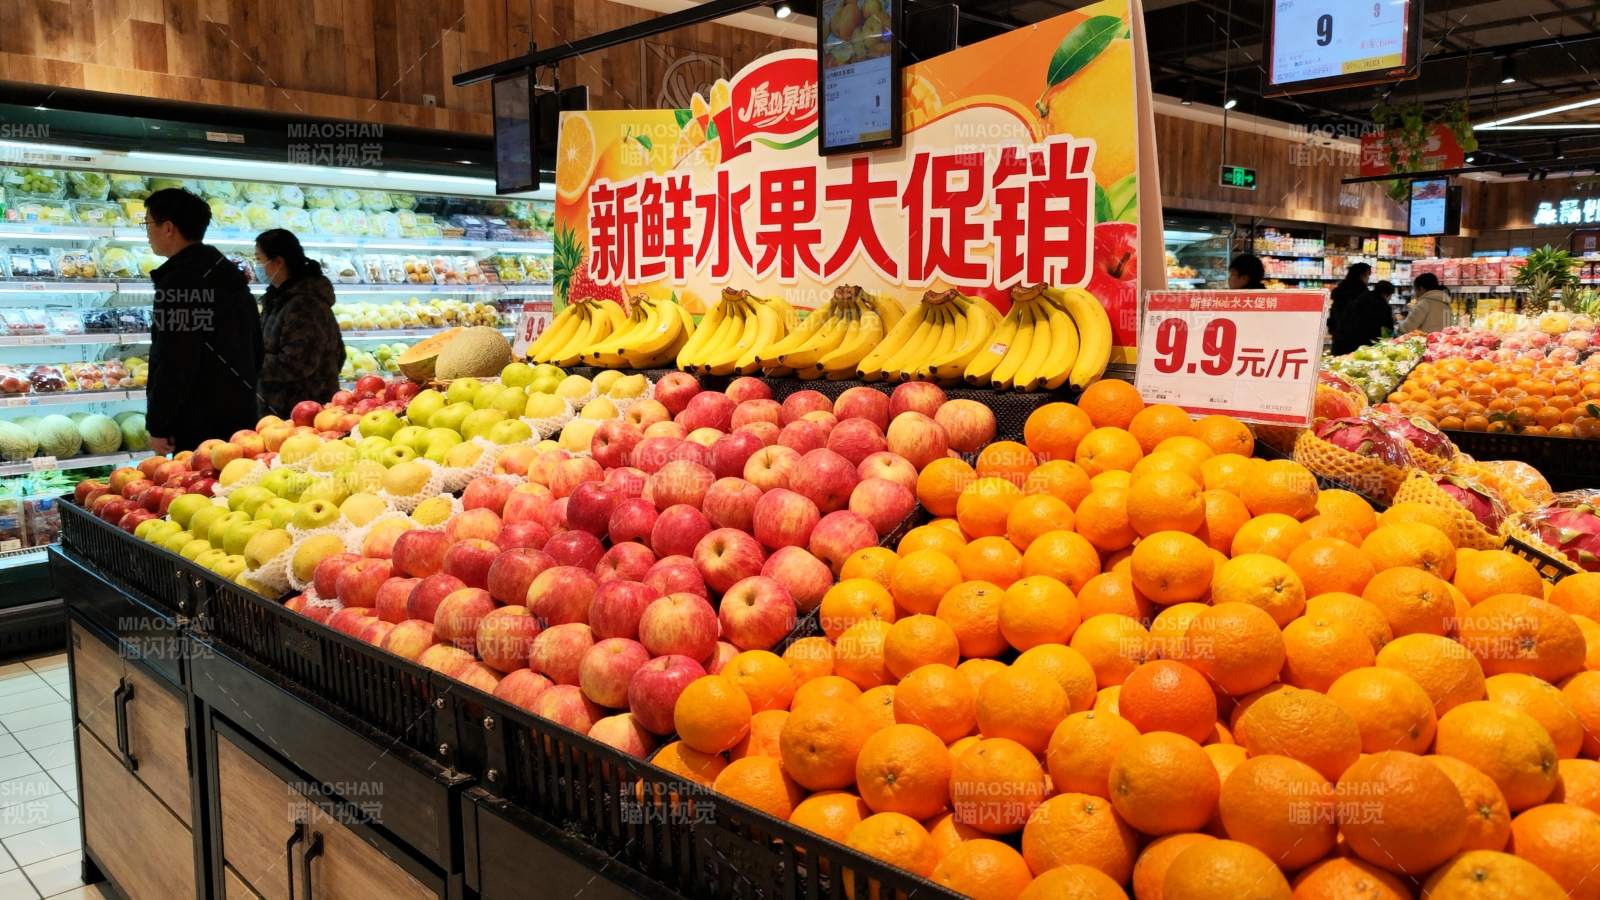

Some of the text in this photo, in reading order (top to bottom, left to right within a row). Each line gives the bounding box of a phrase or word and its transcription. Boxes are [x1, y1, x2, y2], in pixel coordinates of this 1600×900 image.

[1316, 13, 1333, 47] 9
[590, 142, 1089, 284] 新鲜水果大促销
[1154, 317, 1309, 380] 9.9元/斤
